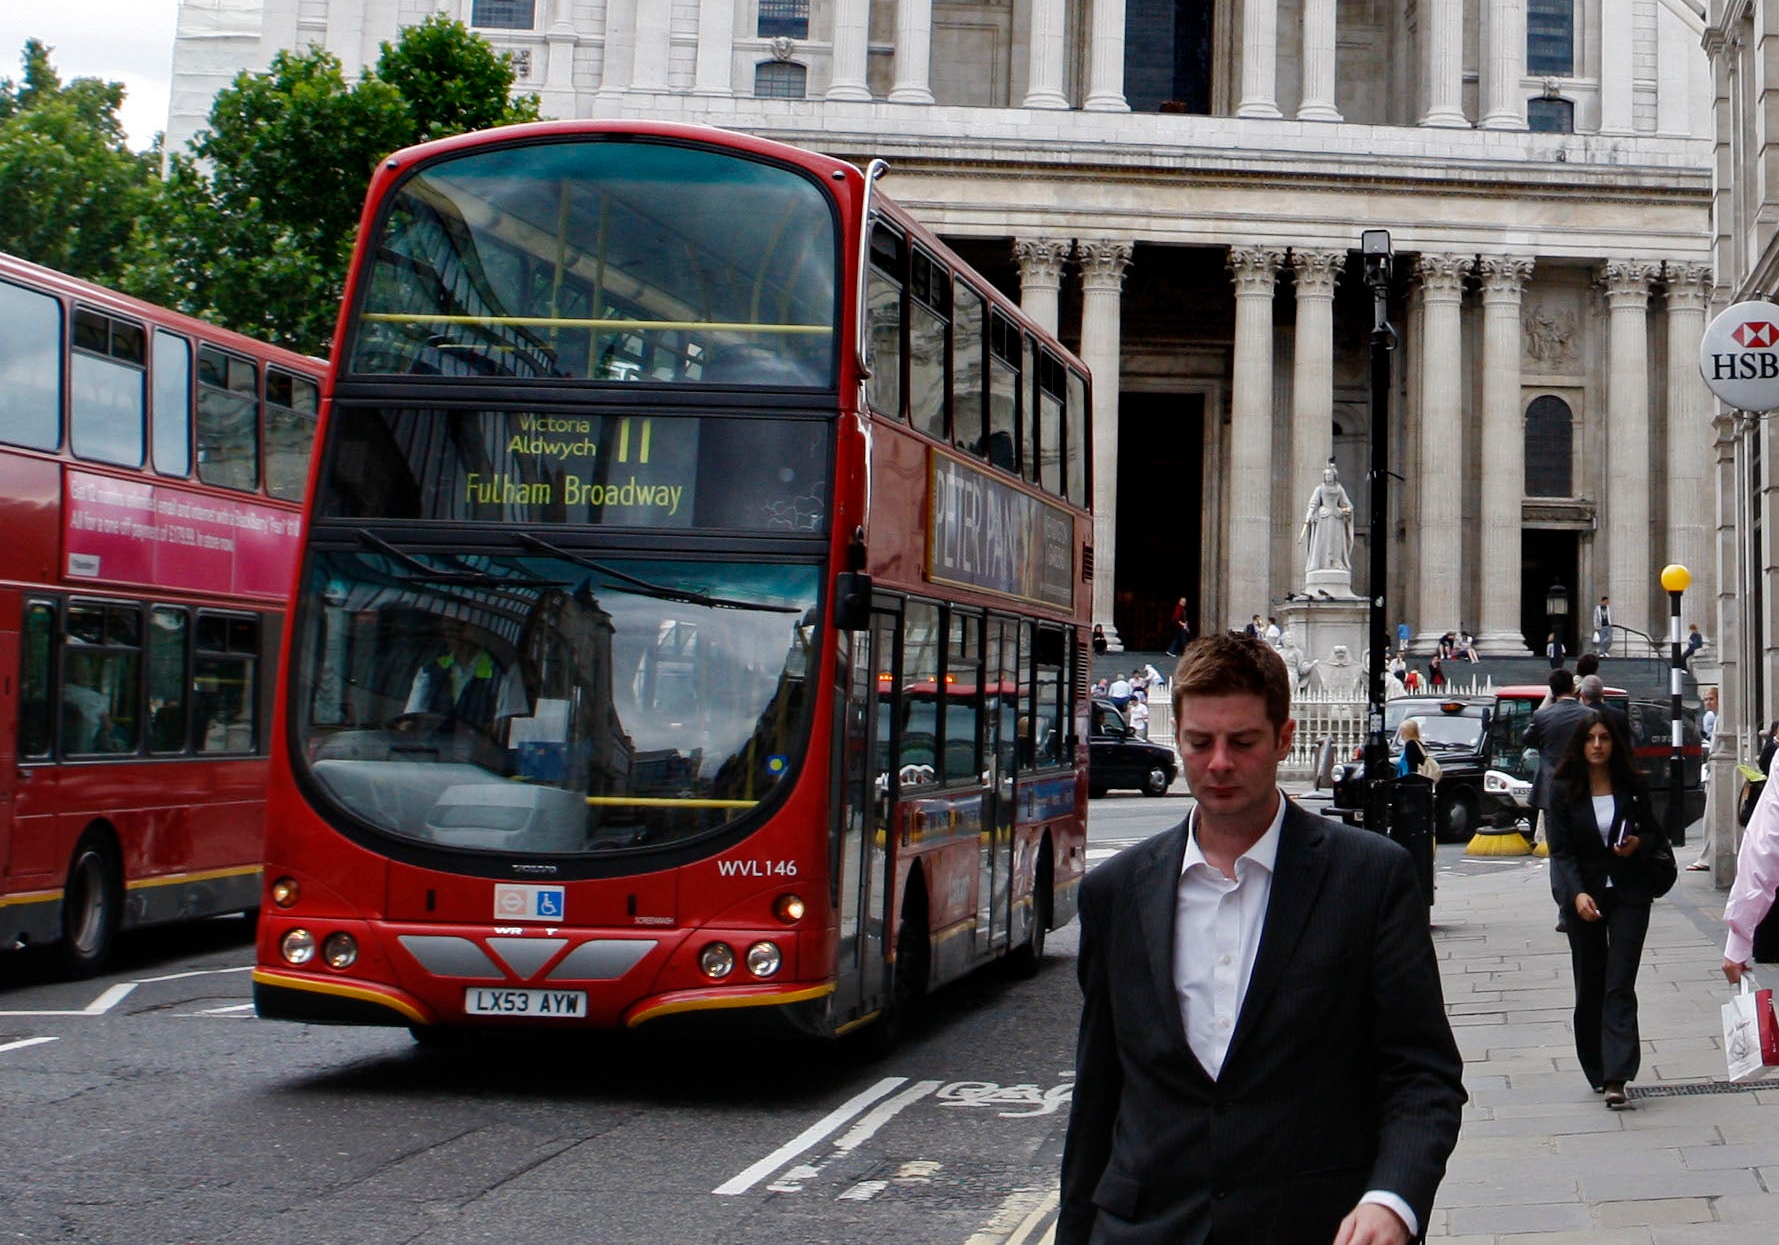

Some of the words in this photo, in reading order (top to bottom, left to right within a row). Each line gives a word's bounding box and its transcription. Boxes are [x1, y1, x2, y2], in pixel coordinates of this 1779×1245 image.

[519, 413, 591, 434] Victoria
[507, 435, 597, 460] Aldwych
[617, 417, 651, 464] 11
[466, 473, 551, 504] Fulham
[564, 474, 683, 515] Broadway
[934, 468, 981, 575] PETER
[717, 860, 798, 877] WVL146
[634, 916, 674, 925] SCREENWASH
[476, 991, 529, 1012] LX53
[539, 993, 579, 1014] AYW
